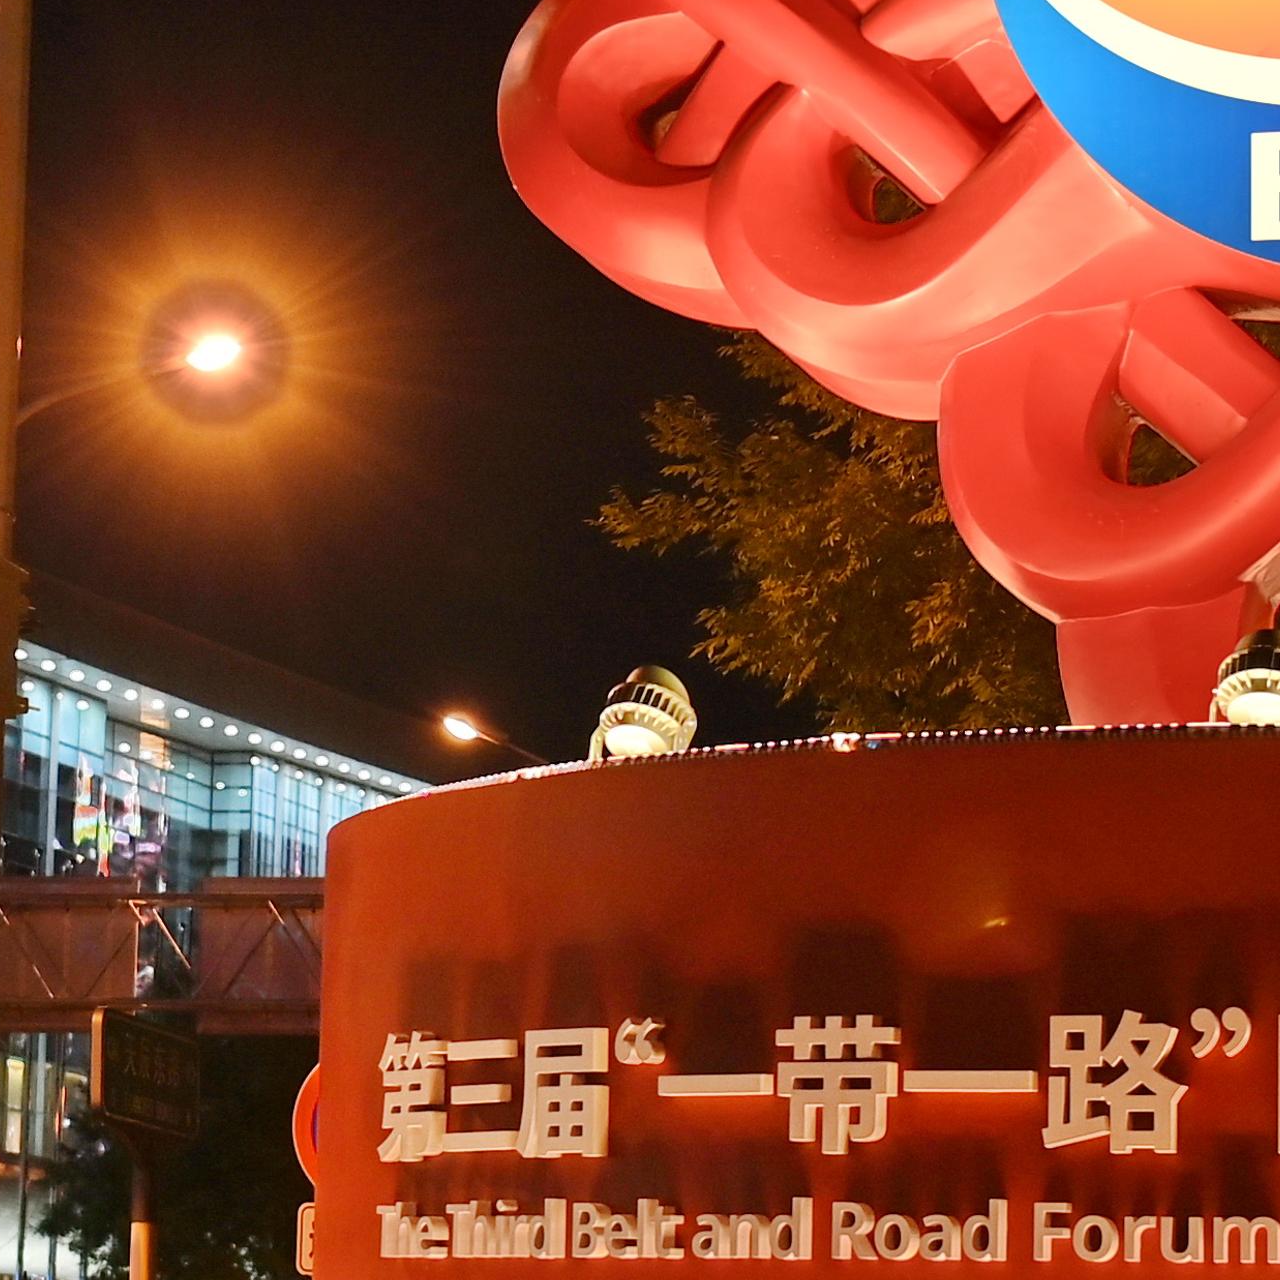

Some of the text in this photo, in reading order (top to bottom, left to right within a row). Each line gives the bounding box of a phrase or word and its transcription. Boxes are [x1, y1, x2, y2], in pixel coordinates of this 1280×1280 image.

[376, 1201, 450, 1258] The
[445, 1197, 567, 1260] Third
[572, 1198, 685, 1260] Belt
[691, 1196, 813, 1261] and
[831, 1198, 1008, 1262] Road
